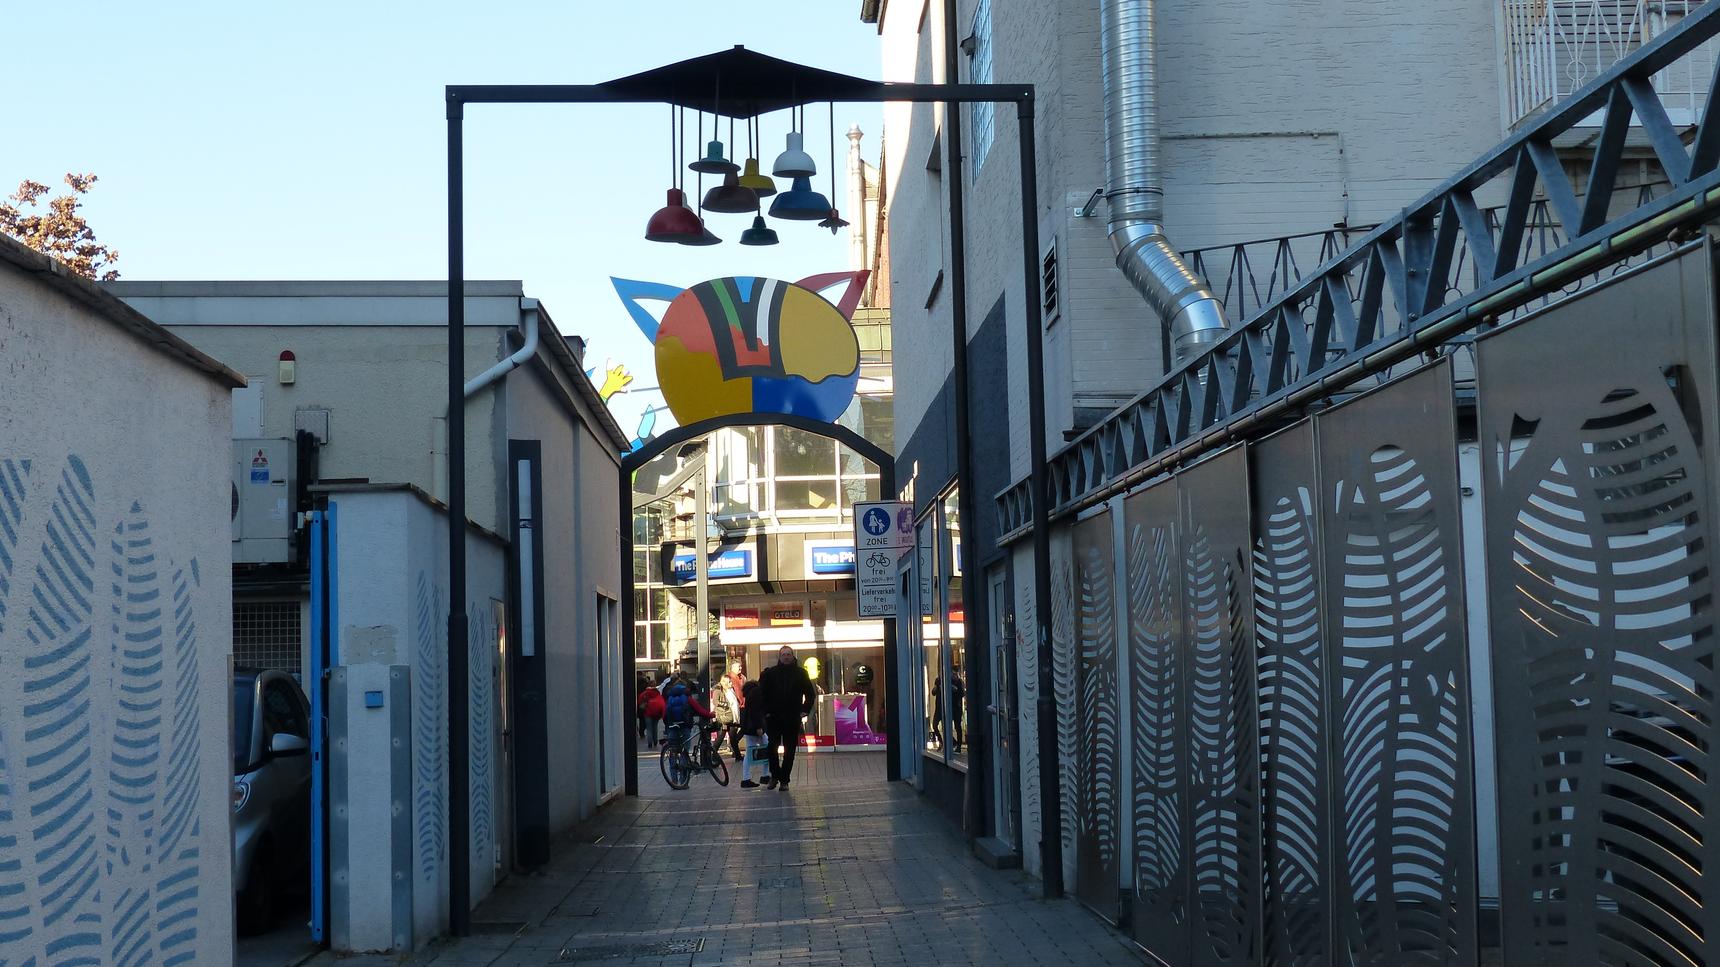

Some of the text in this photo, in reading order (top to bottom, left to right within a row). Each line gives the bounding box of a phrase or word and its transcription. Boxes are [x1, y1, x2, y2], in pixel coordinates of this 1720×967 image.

[814, 552, 839, 563] The
[872, 567, 886, 575] frei
[862, 588, 896, 596] Lieferverkeh
